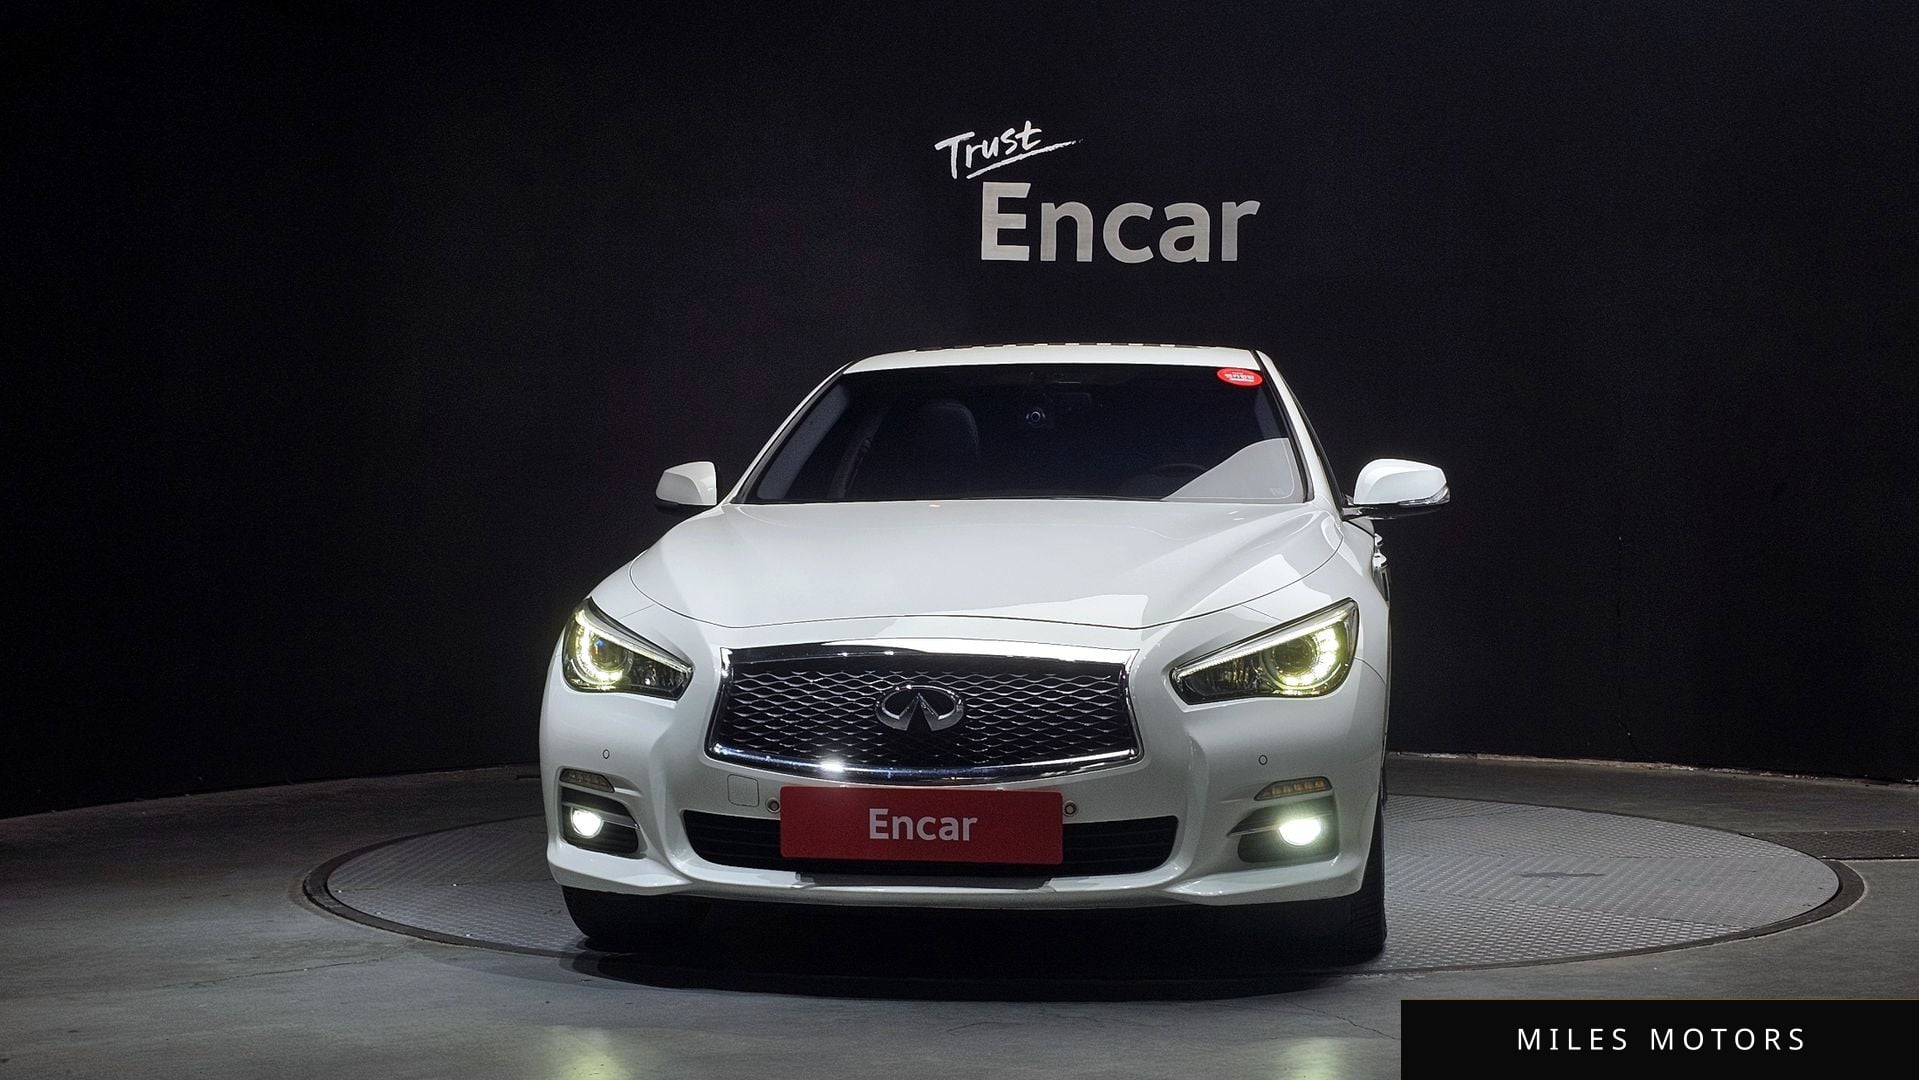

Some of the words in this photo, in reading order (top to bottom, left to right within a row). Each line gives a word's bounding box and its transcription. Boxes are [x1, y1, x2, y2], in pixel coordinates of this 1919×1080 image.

[935, 120, 1043, 180] Trust
[981, 181, 1261, 264] Encar
[868, 808, 978, 841] Encar
